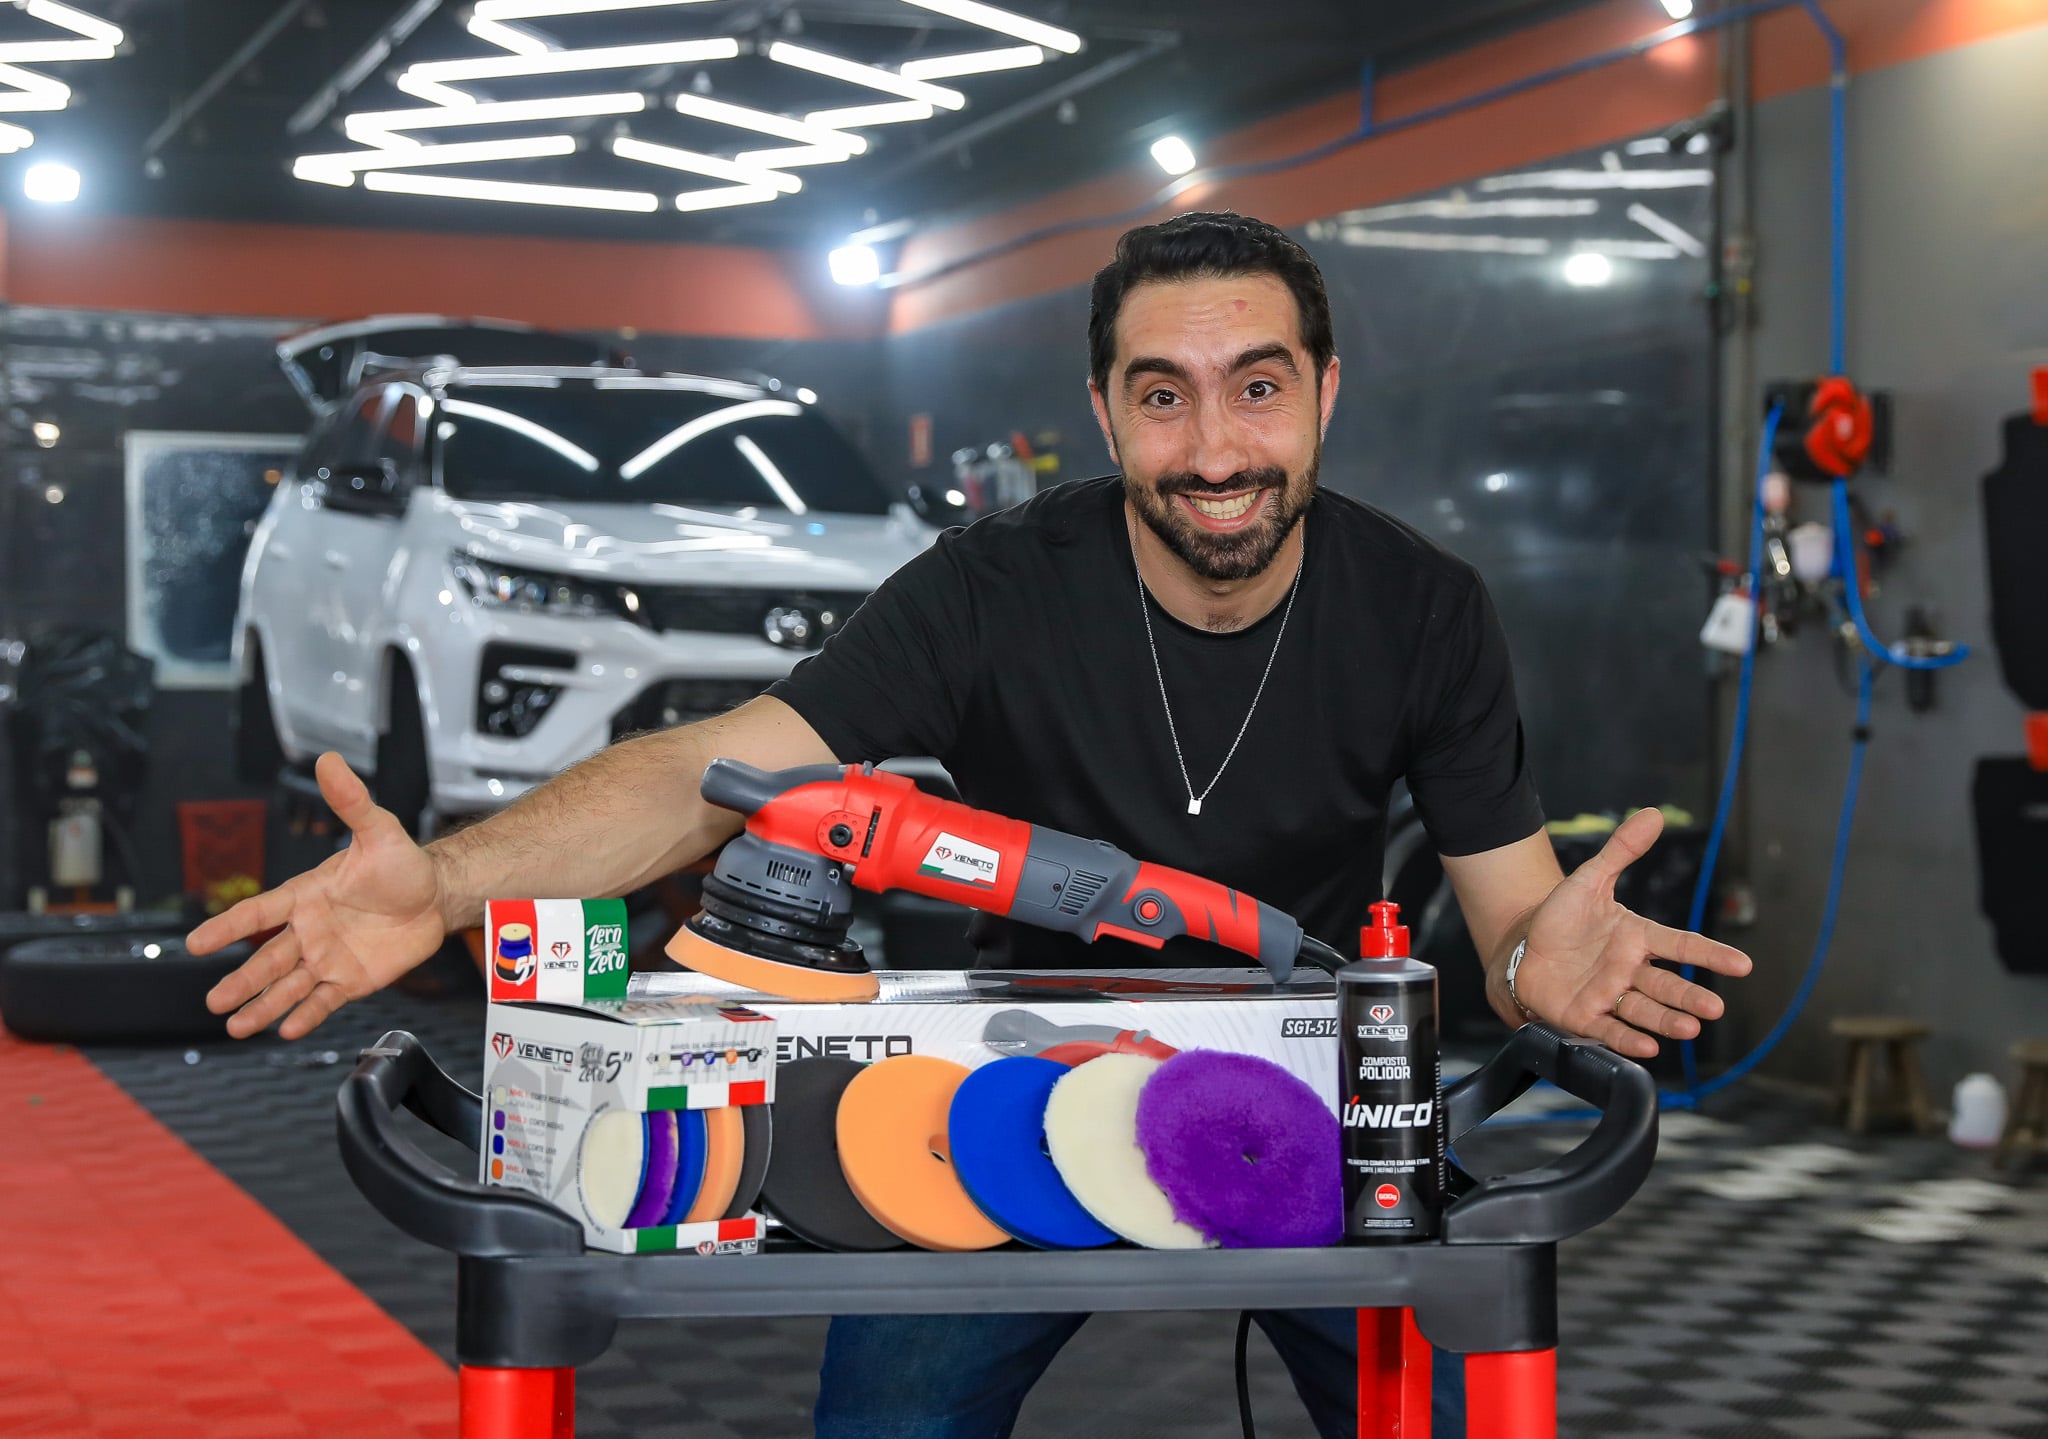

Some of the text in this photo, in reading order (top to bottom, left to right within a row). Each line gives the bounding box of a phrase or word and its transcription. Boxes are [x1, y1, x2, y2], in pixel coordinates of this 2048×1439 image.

[954, 853, 994, 870] VENETO
[586, 924, 622, 950] Zero
[544, 961, 578, 969] VENETO
[588, 951, 626, 975] Zero
[1360, 1026, 1406, 1036] VENETO
[517, 1042, 573, 1064] VENETO
[776, 1036, 912, 1061] ENETO
[1362, 1057, 1407, 1066] COMPOSTO
[1360, 1066, 1411, 1080] POLIDOR
[1344, 1095, 1433, 1128] ÚNICO
